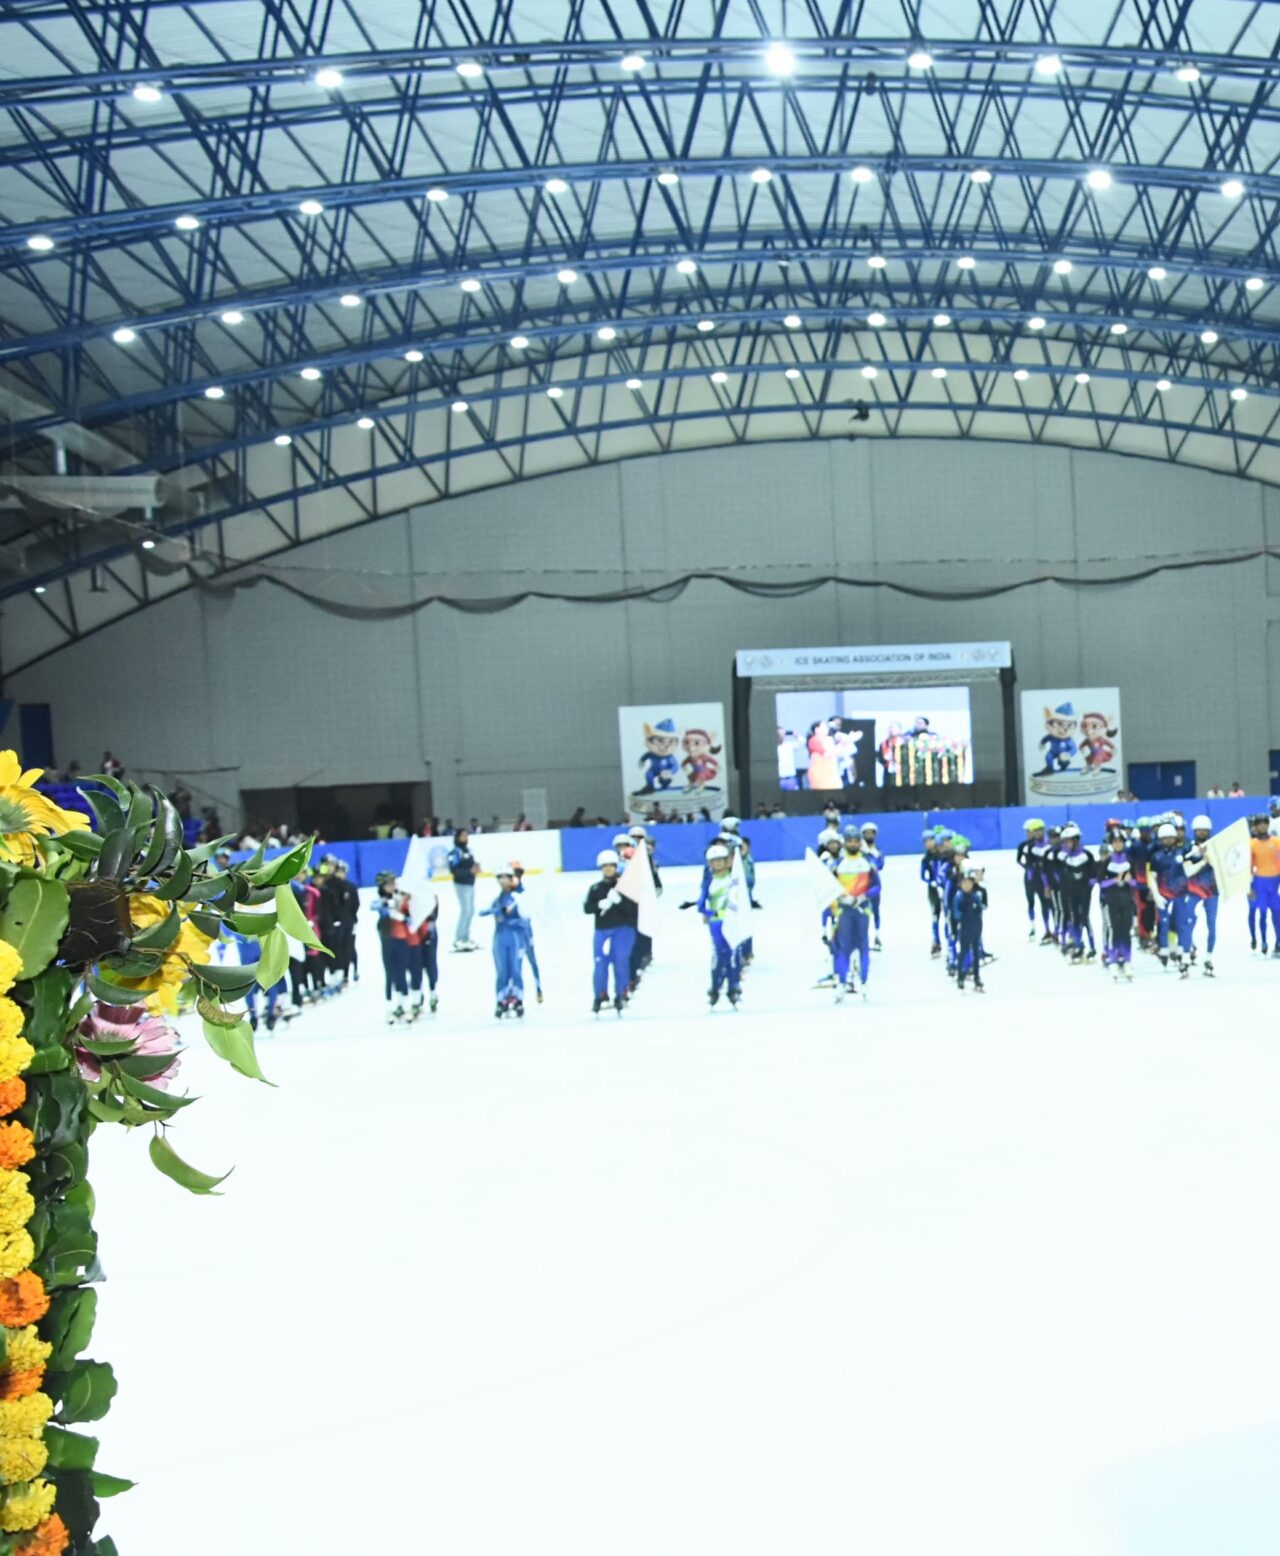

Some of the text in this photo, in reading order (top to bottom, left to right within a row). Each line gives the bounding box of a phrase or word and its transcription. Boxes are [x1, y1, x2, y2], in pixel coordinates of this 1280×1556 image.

[795, 652, 952, 665] ICE SKATING ASSOCIATION OF INDIA
